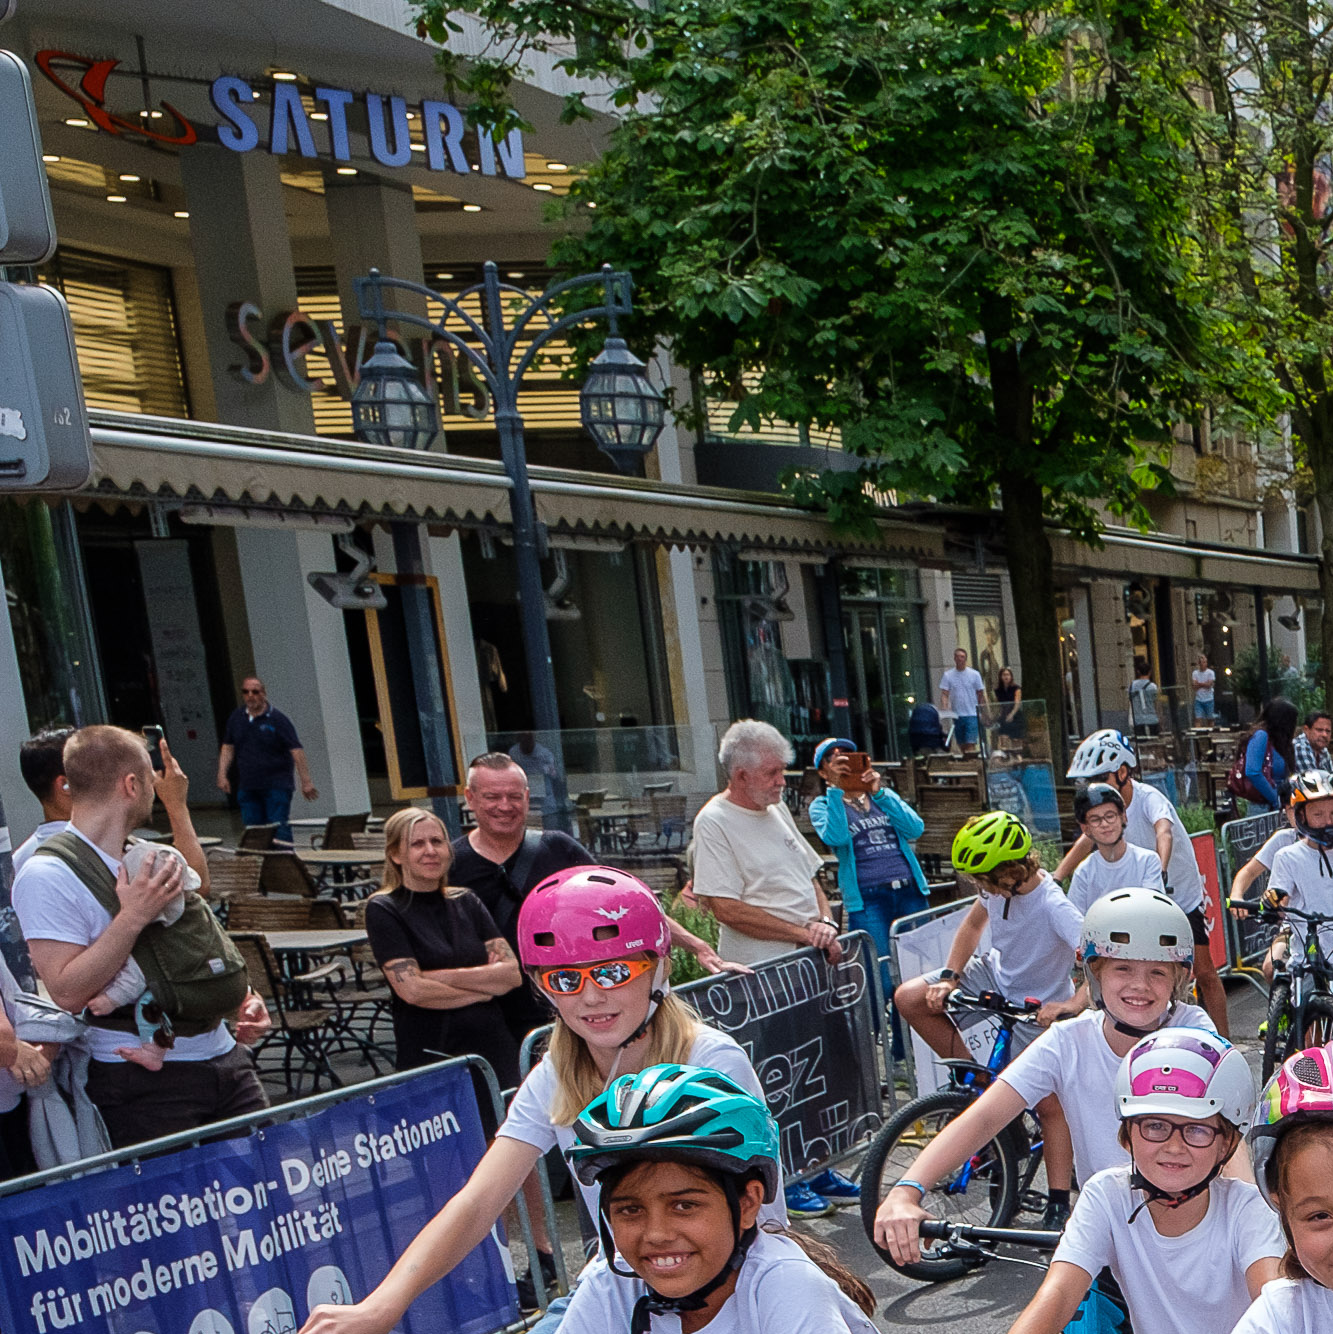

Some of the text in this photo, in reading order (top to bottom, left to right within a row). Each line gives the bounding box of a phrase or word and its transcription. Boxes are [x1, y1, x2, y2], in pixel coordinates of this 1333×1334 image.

[211, 76, 525, 178] SATURN
[281, 1148, 352, 1197] Deine
[354, 1110, 461, 1169] Stationen
[30, 1288, 83, 1334] für
[90, 1249, 218, 1318] moderne
